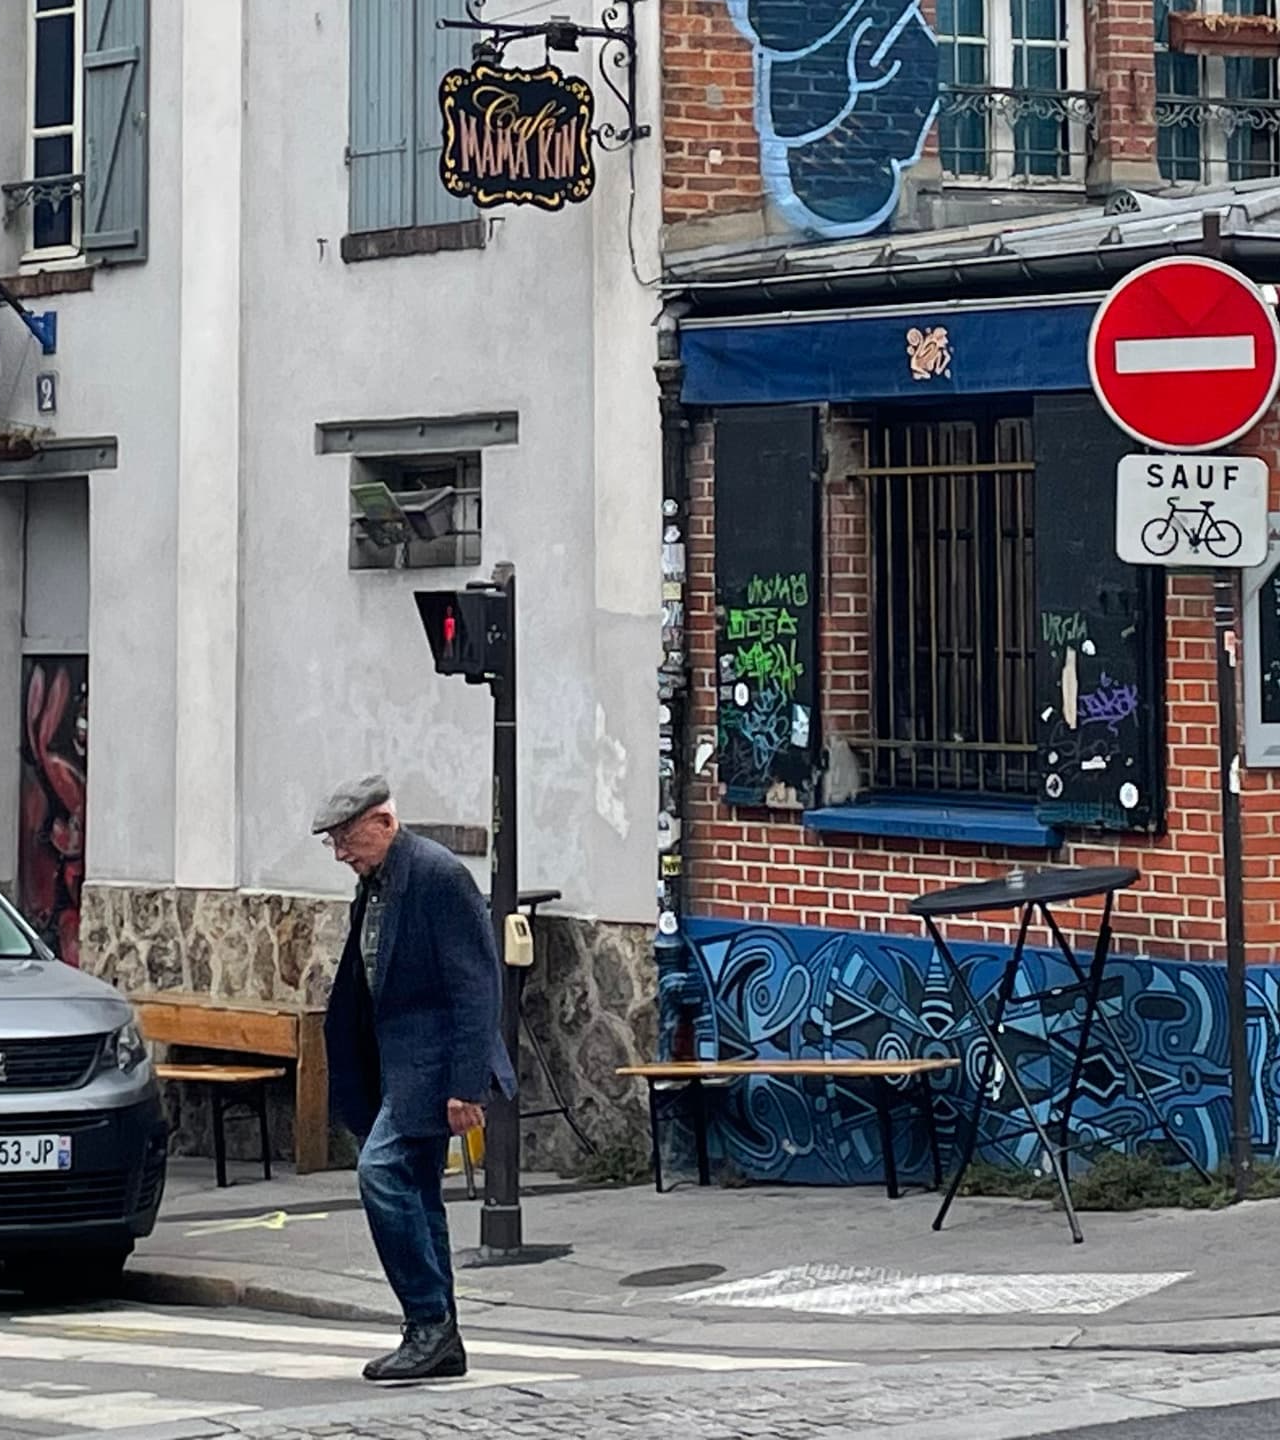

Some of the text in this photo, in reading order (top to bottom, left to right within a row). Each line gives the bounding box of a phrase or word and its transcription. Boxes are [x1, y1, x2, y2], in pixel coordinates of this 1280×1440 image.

[472, 85, 567, 141] Café
[459, 109, 578, 180] MAMA KIN
[1147, 464, 1239, 491] SAUF
